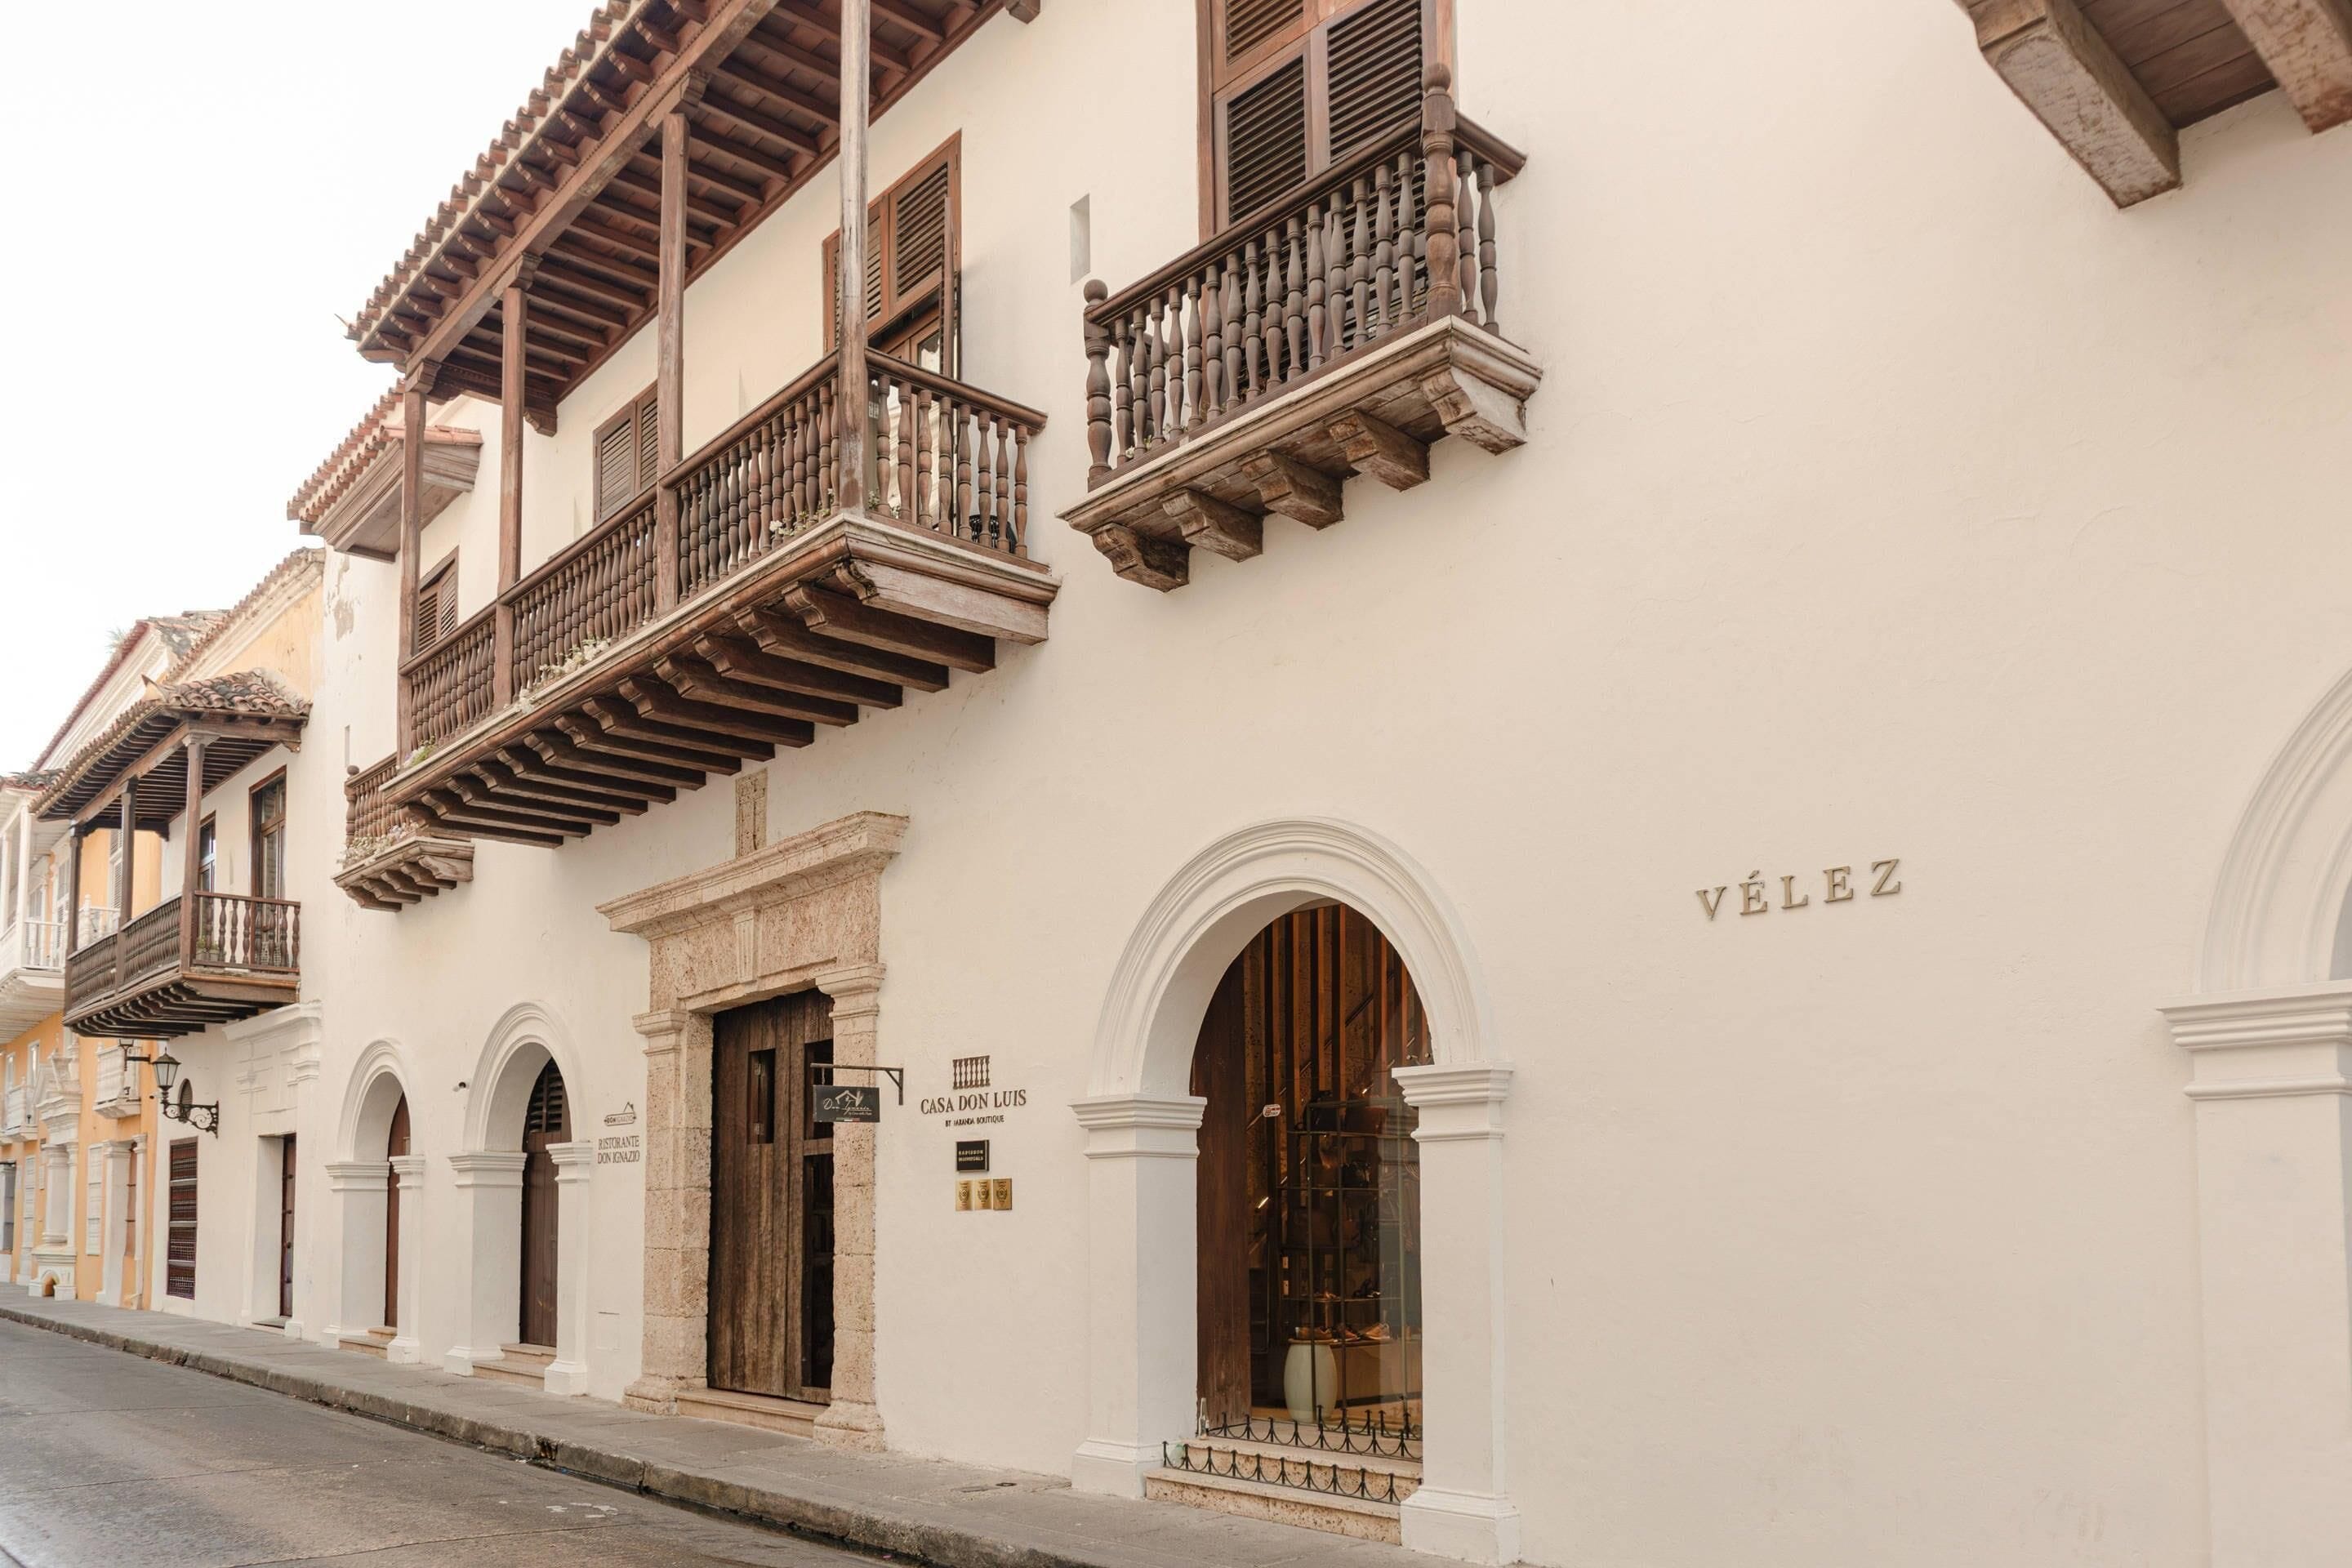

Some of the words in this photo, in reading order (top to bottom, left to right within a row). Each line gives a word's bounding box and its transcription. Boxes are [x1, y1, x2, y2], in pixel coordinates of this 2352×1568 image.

[1696, 858, 1901, 921] VÉLEZ
[920, 1097, 954, 1115] CASA
[959, 1093, 989, 1111] DON
[994, 1089, 1027, 1107] LUIS
[977, 1115, 1004, 1124] BOUTIQUE
[598, 1135, 639, 1150] RISTORANTE
[597, 1152, 611, 1164] DON
[612, 1150, 640, 1164] IGNAZIO
